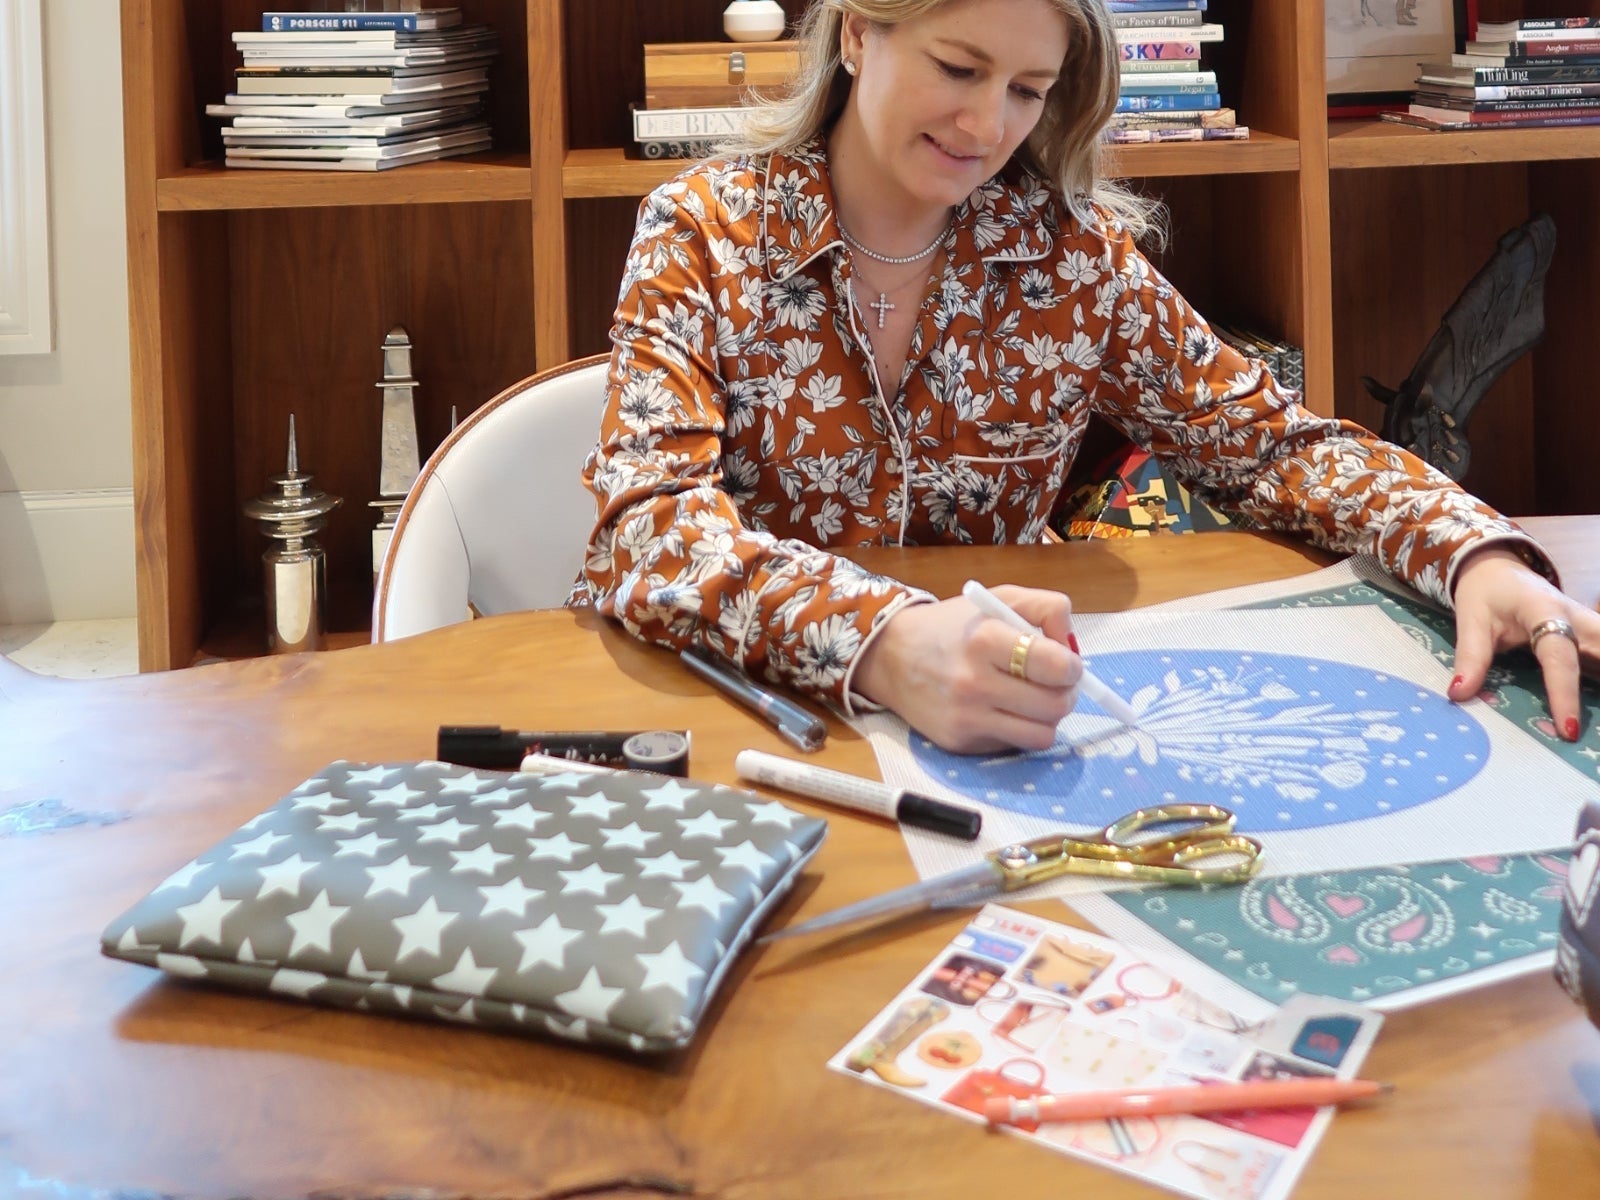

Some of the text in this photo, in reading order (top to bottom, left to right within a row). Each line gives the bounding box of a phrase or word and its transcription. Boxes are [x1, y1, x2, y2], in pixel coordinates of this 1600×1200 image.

[290, 18, 339, 29] PORSCHE
[342, 18, 357, 28] 911
[1129, 15, 1156, 26] Faces
[1158, 15, 1168, 25] of
[1168, 15, 1195, 25] Time
[1180, 85, 1206, 95] Degas
[1551, 86, 1582, 96] minera
